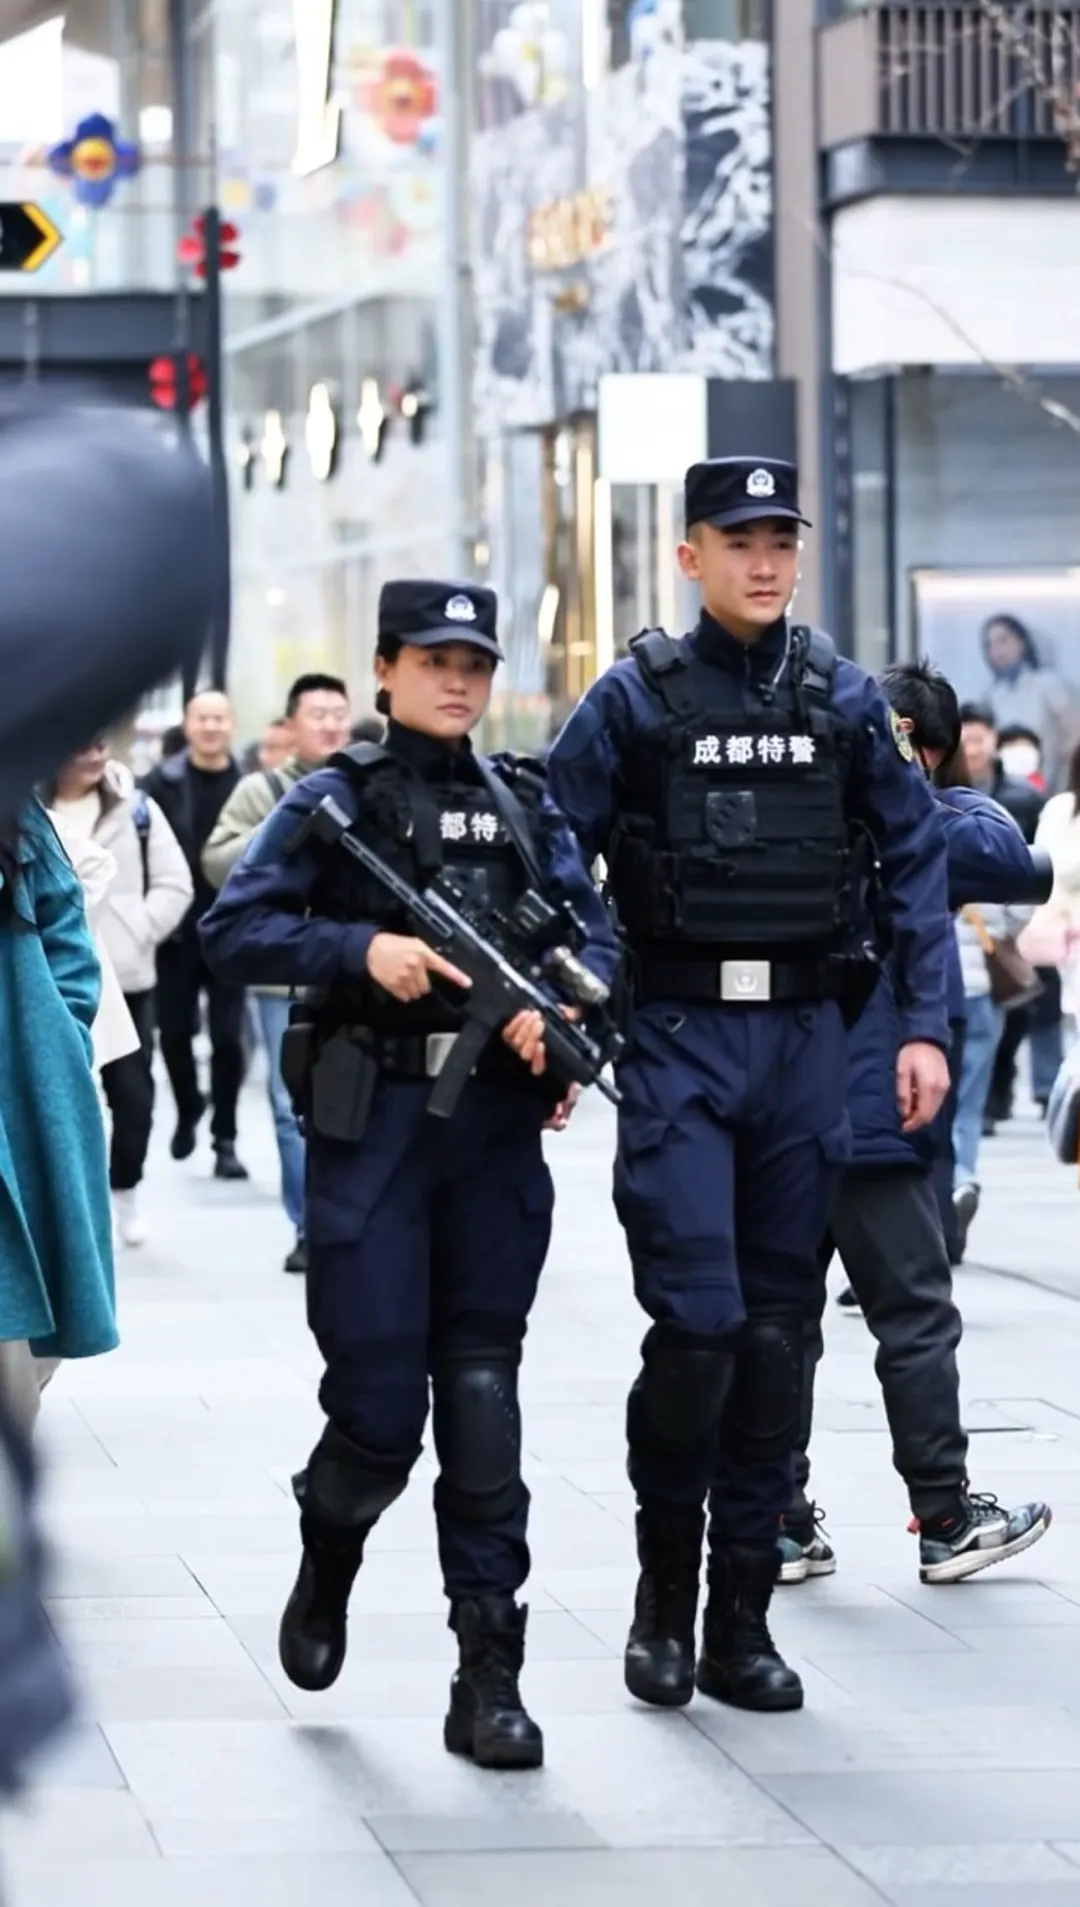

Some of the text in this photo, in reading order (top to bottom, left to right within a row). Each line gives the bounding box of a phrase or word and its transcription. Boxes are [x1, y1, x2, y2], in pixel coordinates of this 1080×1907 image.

[693, 734, 816, 765] 成都特警
[406, 810, 512, 842] 都特
